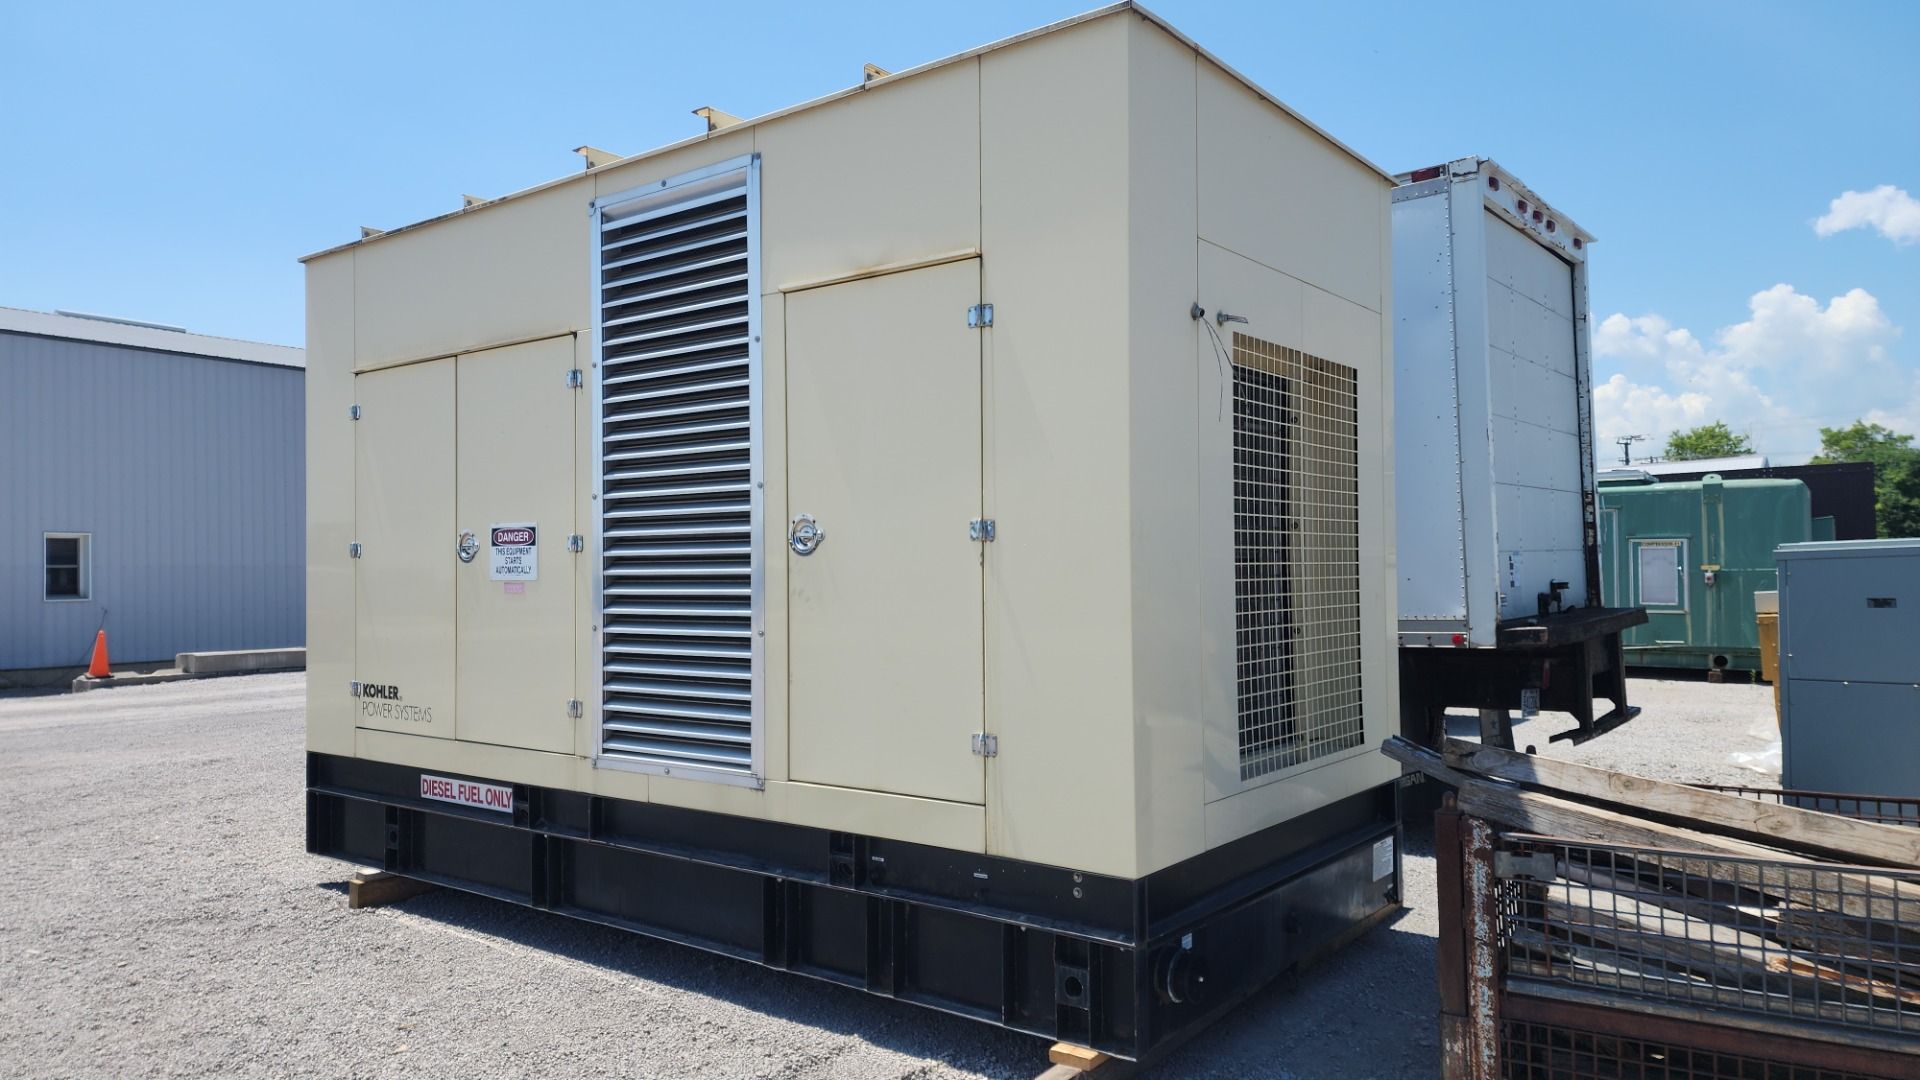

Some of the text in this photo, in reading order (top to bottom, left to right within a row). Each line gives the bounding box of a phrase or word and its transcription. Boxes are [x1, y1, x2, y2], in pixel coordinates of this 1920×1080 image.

[497, 531, 529, 542] DANGER
[495, 547, 532, 556] THIS EQUIPMENT
[504, 556, 522, 565] STARTS
[495, 566, 532, 575] AUTOMATICALLY
[362, 683, 399, 701] KOHLER
[362, 701, 432, 723] POWER SYSTEMS
[422, 778, 513, 809] DIESEL FUEL ONLY
